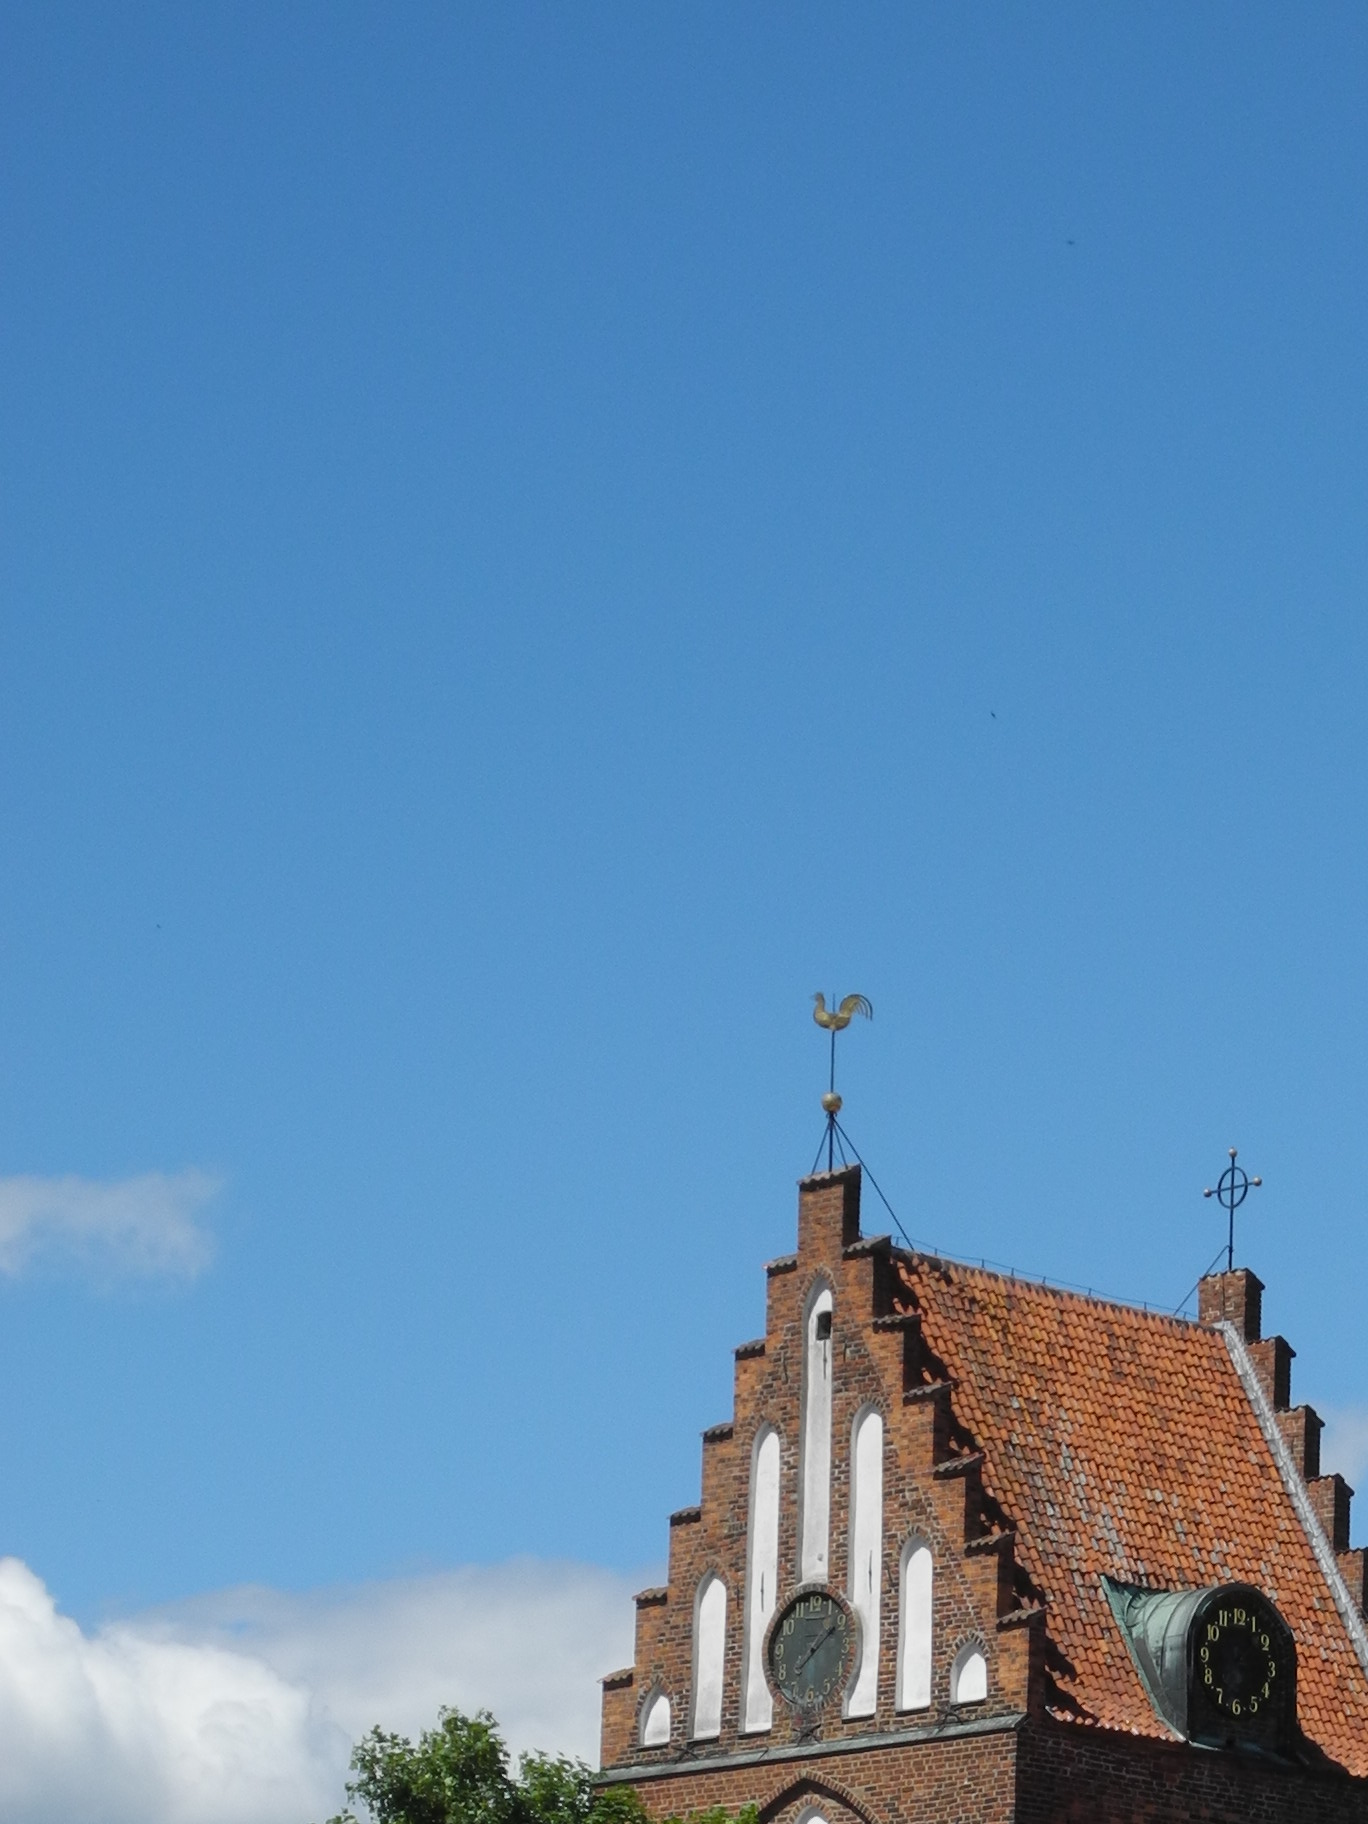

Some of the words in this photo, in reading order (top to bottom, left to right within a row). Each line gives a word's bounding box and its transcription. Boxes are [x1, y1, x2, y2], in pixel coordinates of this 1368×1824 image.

[795, 1602, 804, 1618] 11
[809, 1596, 822, 1613] 12
[828, 1599, 833, 1615] 1
[837, 1614, 846, 1630] 2
[1218, 1609, 1228, 1627] 11
[1233, 1608, 1246, 1626] 12
[1251, 1616, 1256, 1632] 1
[783, 1619, 795, 1636] 10
[1207, 1624, 1219, 1641] 10
[841, 1637, 849, 1653] 3
[1260, 1634, 1270, 1651] 2
[775, 1644, 784, 1660] 9
[1200, 1646, 1209, 1662] 9
[778, 1664, 786, 1680] 8
[835, 1660, 843, 1676] 4
[1204, 1668, 1213, 1684] 8
[1267, 1661, 1276, 1677] 3
[791, 1681, 799, 1698] 7
[823, 1679, 831, 1694] 5
[1261, 1682, 1270, 1699] 4
[806, 1687, 814, 1703] 6
[1216, 1688, 1223, 1704] 7
[1232, 1699, 1241, 1715] 6
[1249, 1696, 1258, 1712] 5
